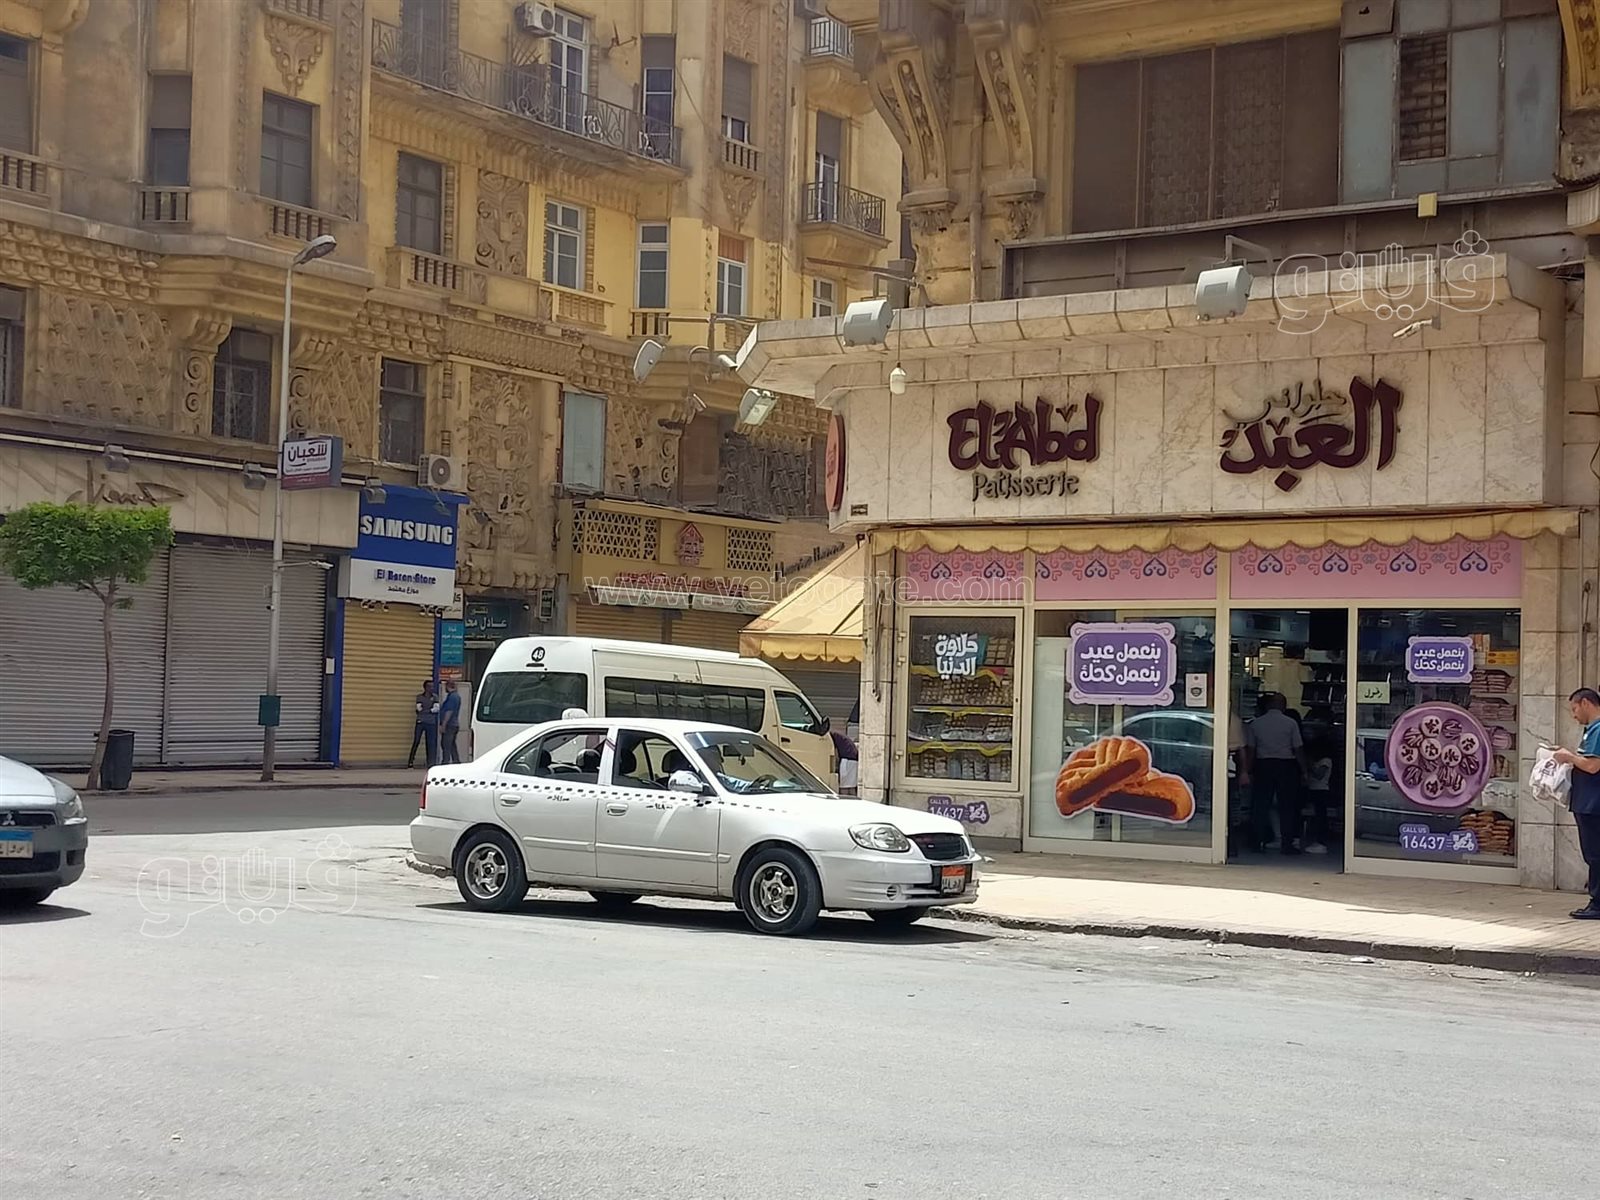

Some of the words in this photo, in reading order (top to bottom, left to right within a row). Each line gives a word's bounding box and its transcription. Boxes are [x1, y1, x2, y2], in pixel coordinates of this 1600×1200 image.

[1219, 376, 1404, 492] العبد
[288, 441, 328, 462] شعبان
[972, 471, 1080, 502] Patisserie
[360, 515, 454, 546] SAMSUNG
[532, 649, 544, 660] 48
[935, 632, 979, 657] حلاوة
[1080, 645, 1115, 663] عيد
[1115, 643, 1162, 664] بنعمل
[1414, 648, 1437, 660] عيد
[1437, 647, 1465, 661] بنعمل
[936, 656, 977, 680] الدنيا
[1115, 665, 1161, 687] بنعمل
[1436, 659, 1465, 673] بنعمل
[1402, 835, 1445, 850] 16437
